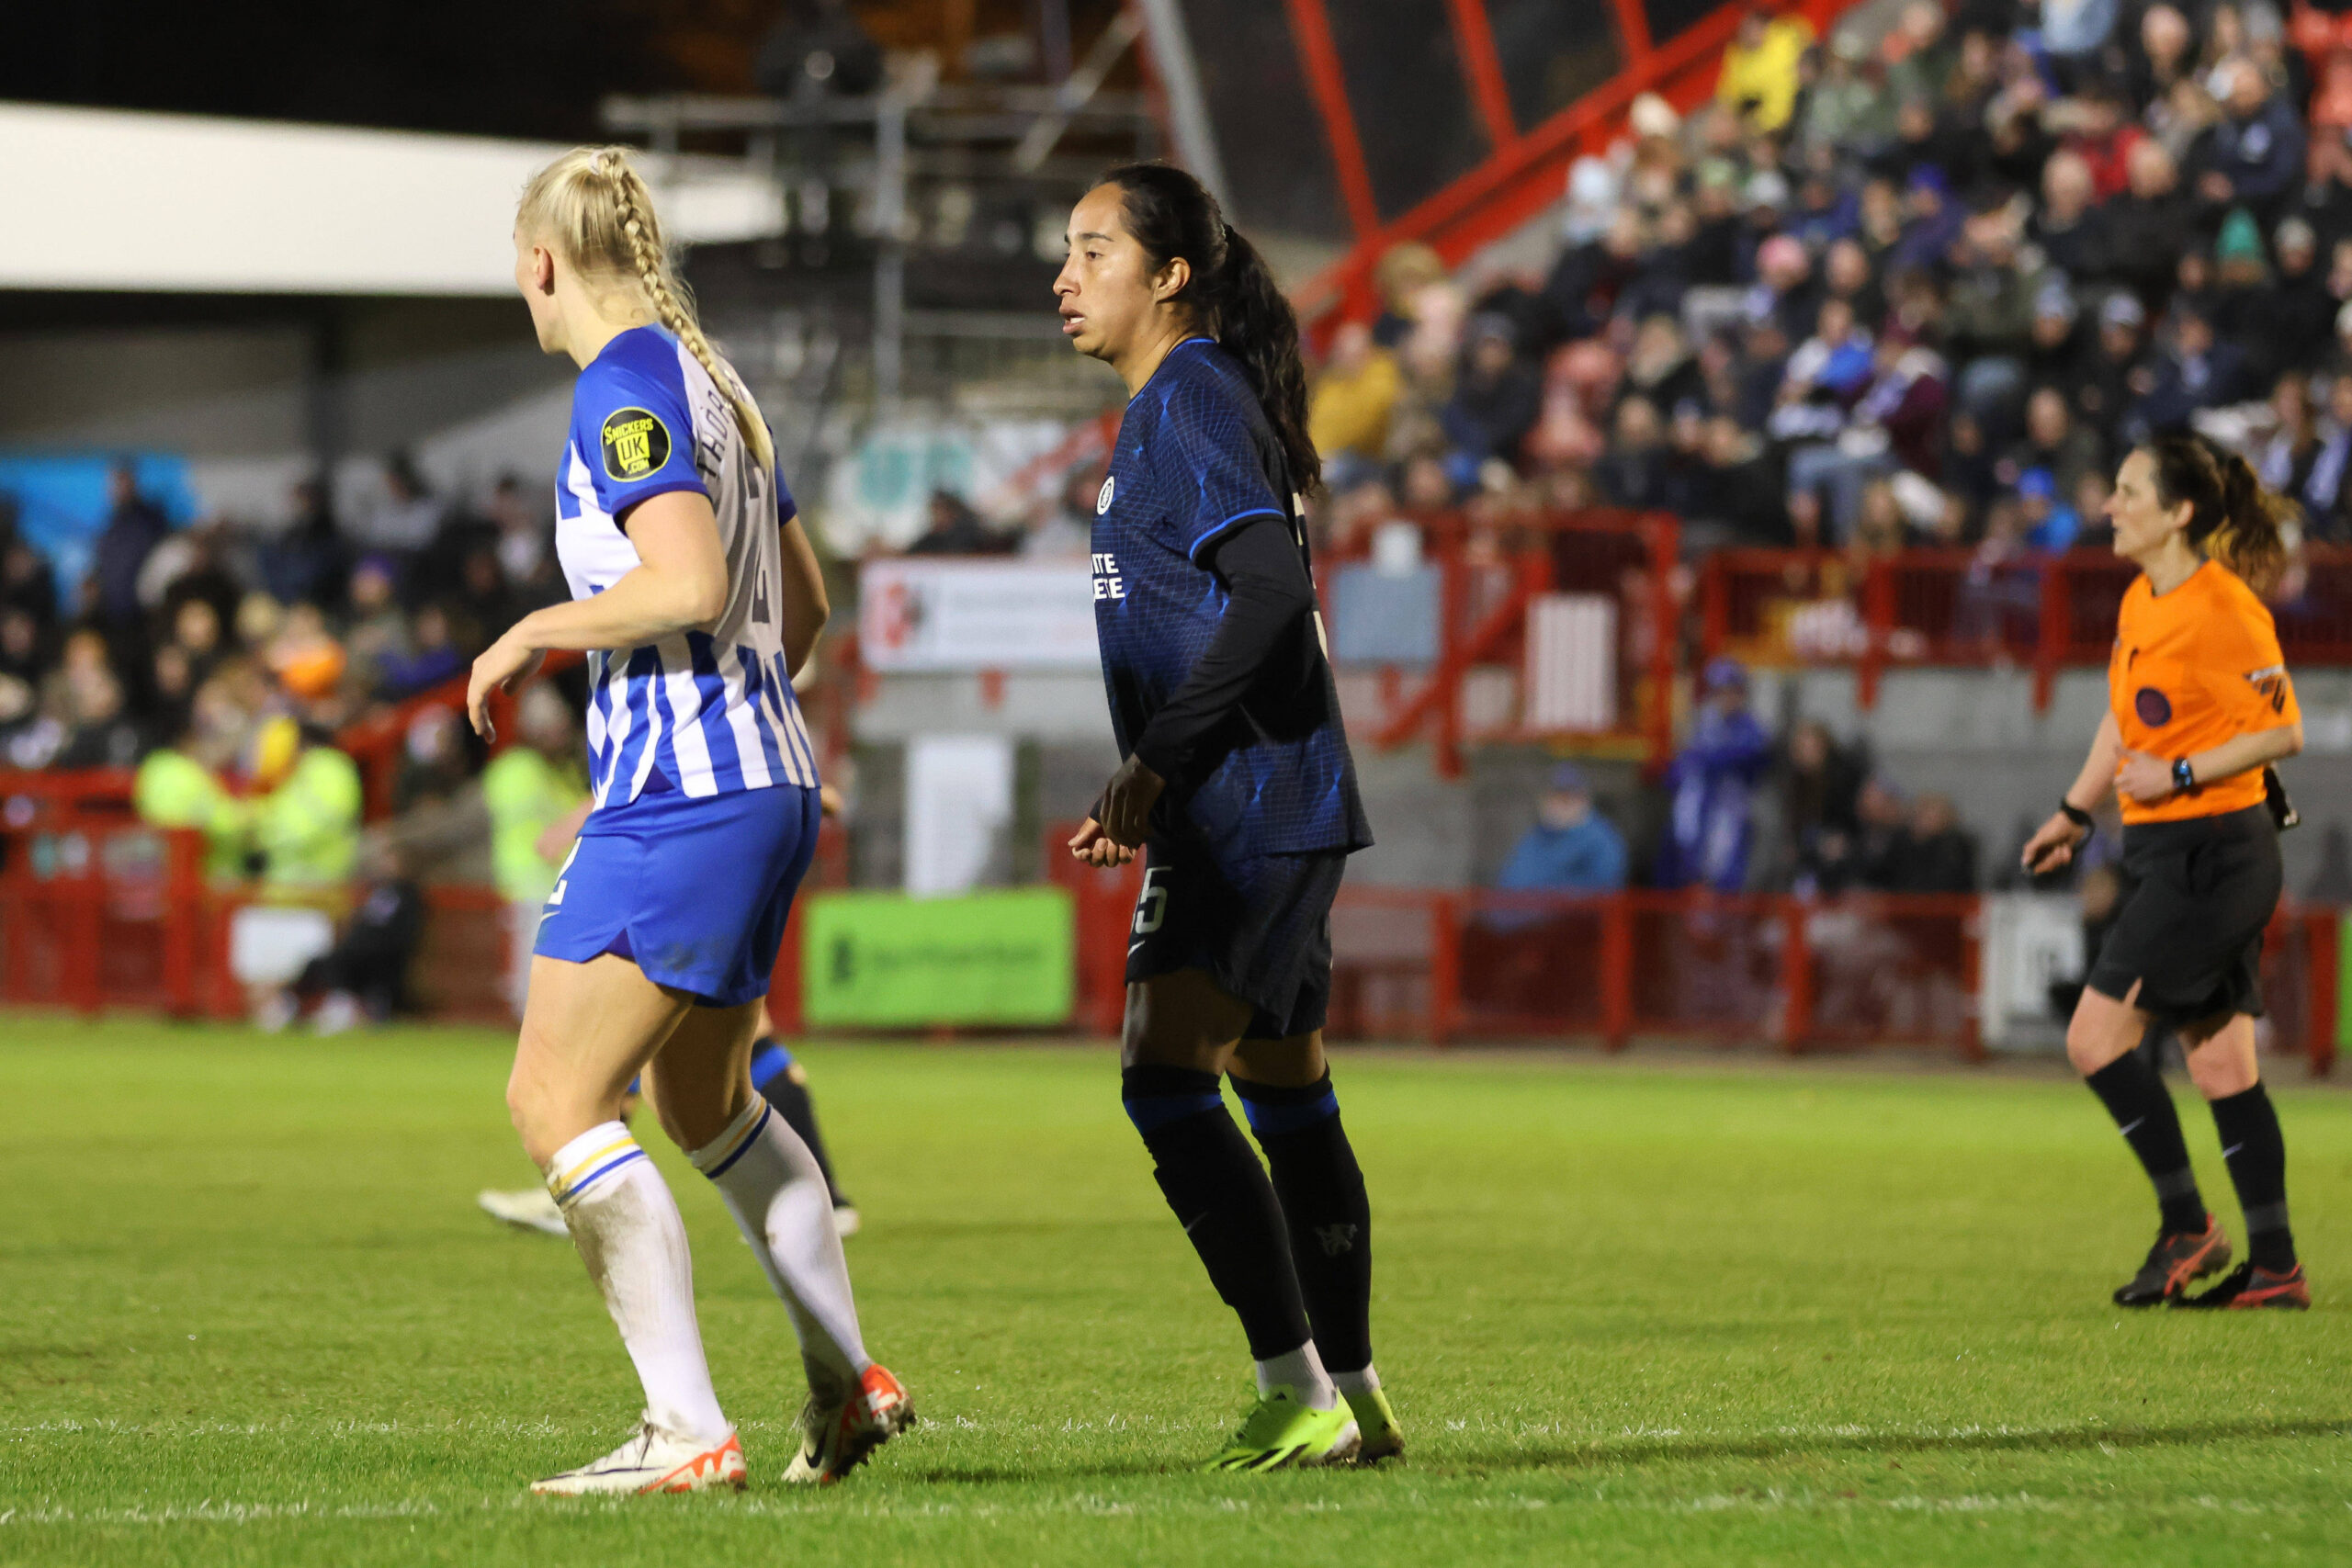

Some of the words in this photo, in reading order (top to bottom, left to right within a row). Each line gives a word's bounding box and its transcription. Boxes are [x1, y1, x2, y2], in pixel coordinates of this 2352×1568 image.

[604, 417, 654, 446] SNICKERS
[620, 435, 646, 461] UK
[1091, 553, 1120, 574] ITE
[1093, 577, 1125, 603] ETE
[1131, 866, 1173, 934] 5
